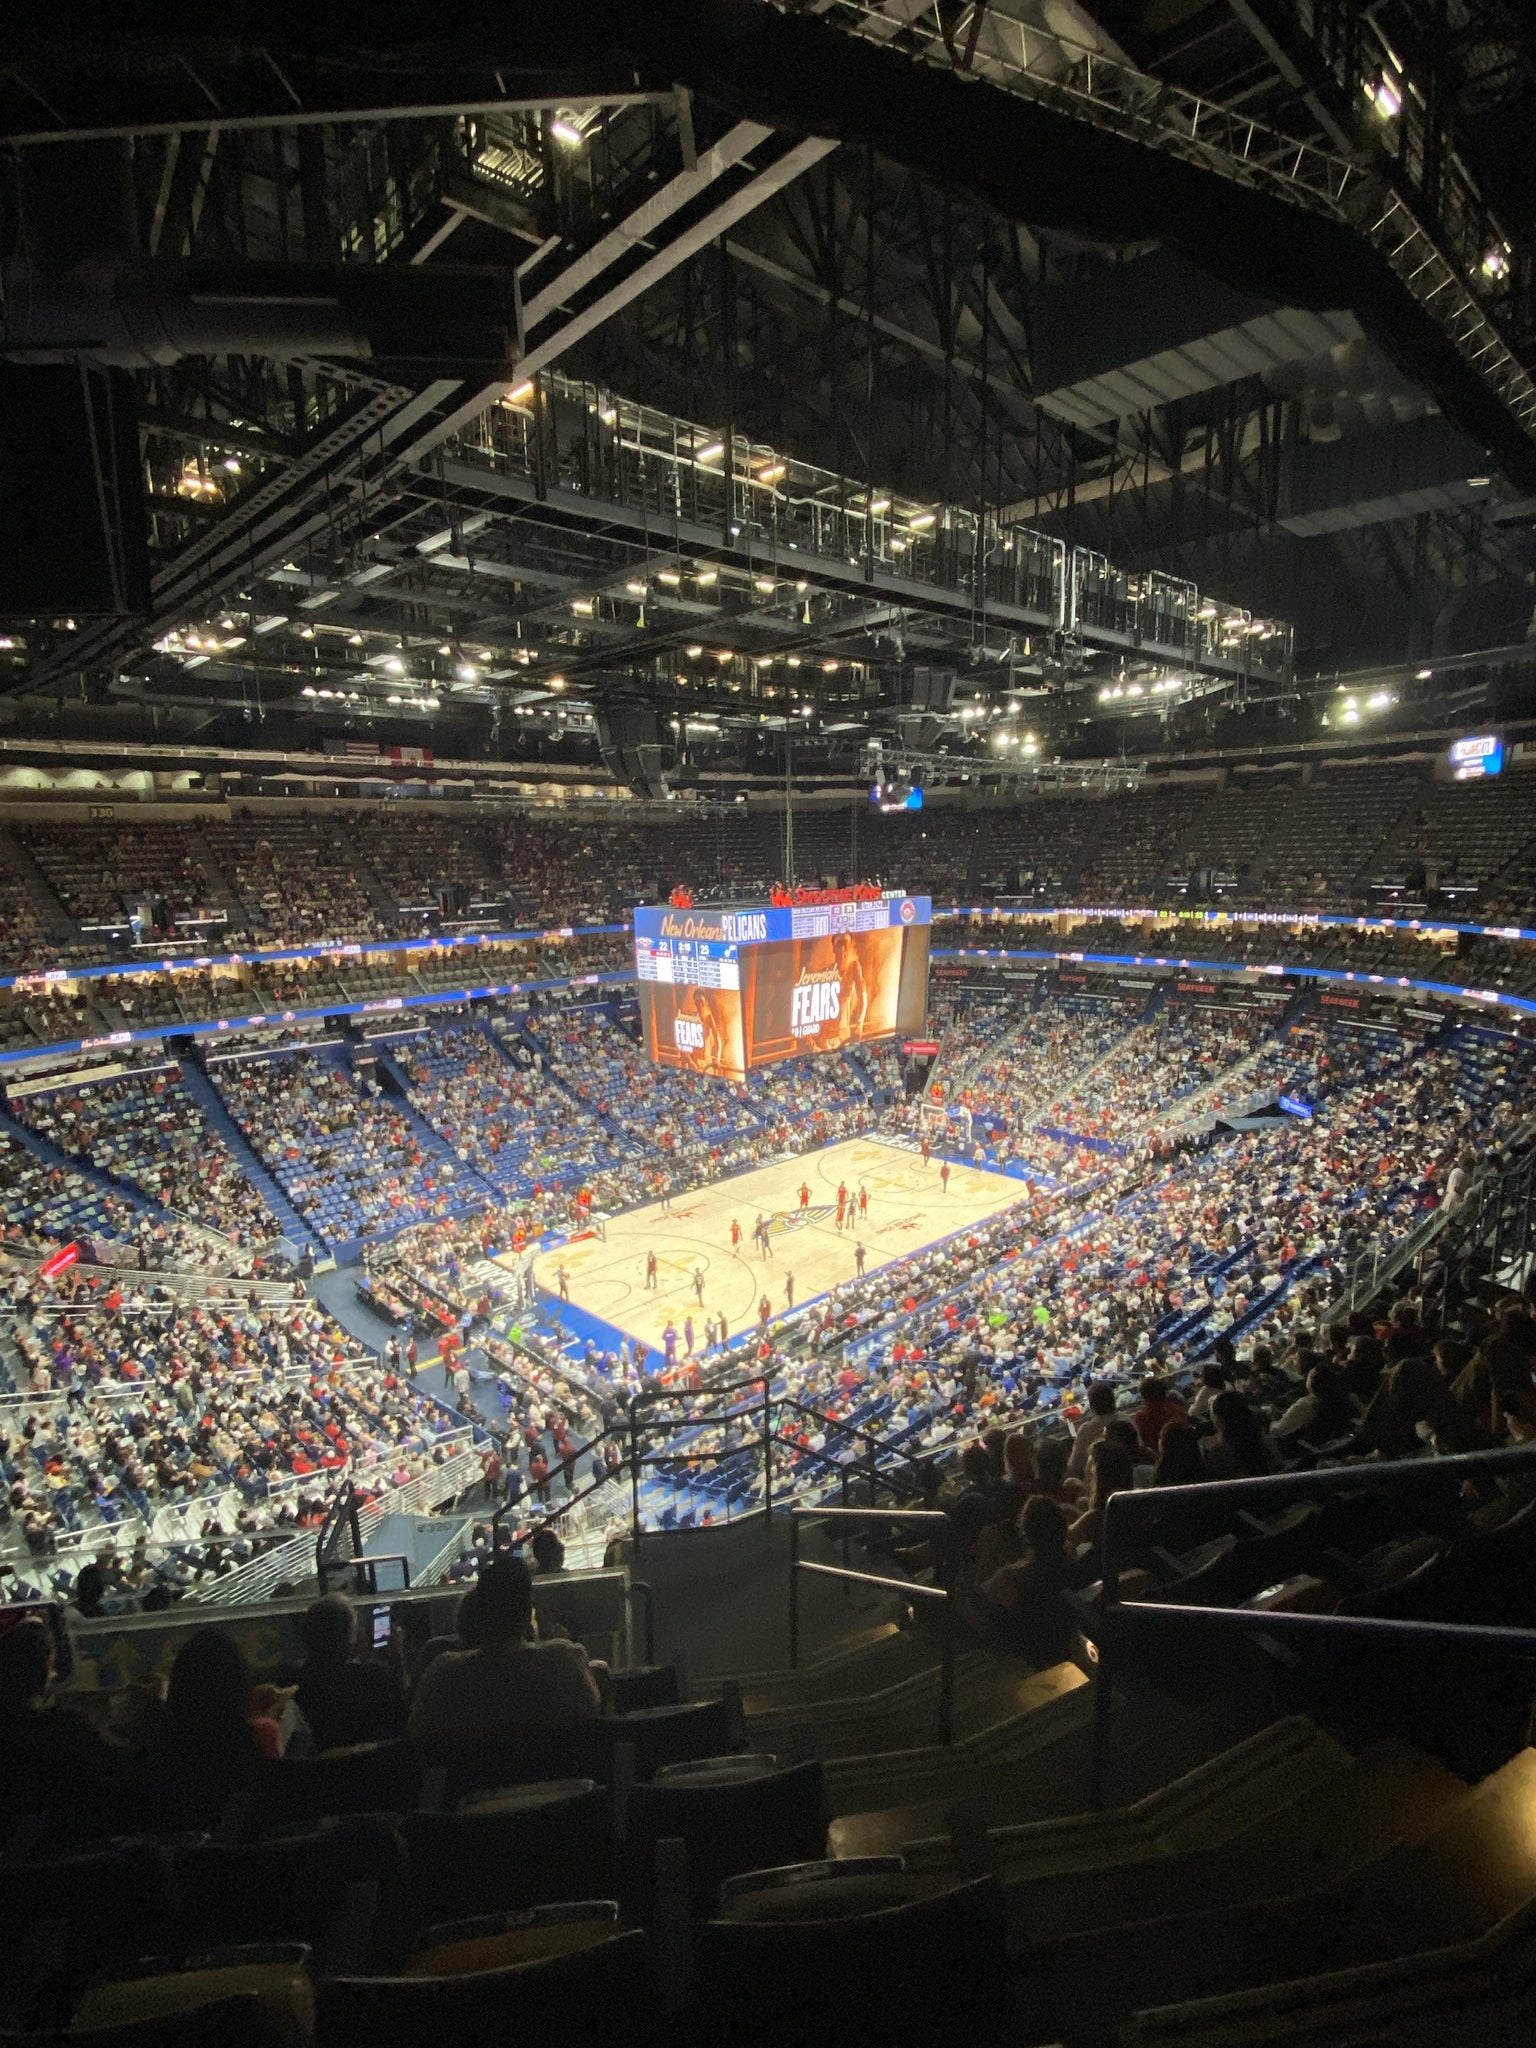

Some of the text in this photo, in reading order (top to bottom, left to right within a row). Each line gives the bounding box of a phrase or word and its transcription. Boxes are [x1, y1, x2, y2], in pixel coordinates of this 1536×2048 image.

[881, 890, 907, 899] CENTER
[661, 913, 724, 940] New Orleans
[721, 913, 767, 942] PELICANS
[658, 941, 669, 951] 22
[699, 944, 710, 956] 25
[794, 962, 843, 987] Jeremiah
[791, 980, 841, 1027] FEARS
[674, 1019, 705, 1049] FEARS
